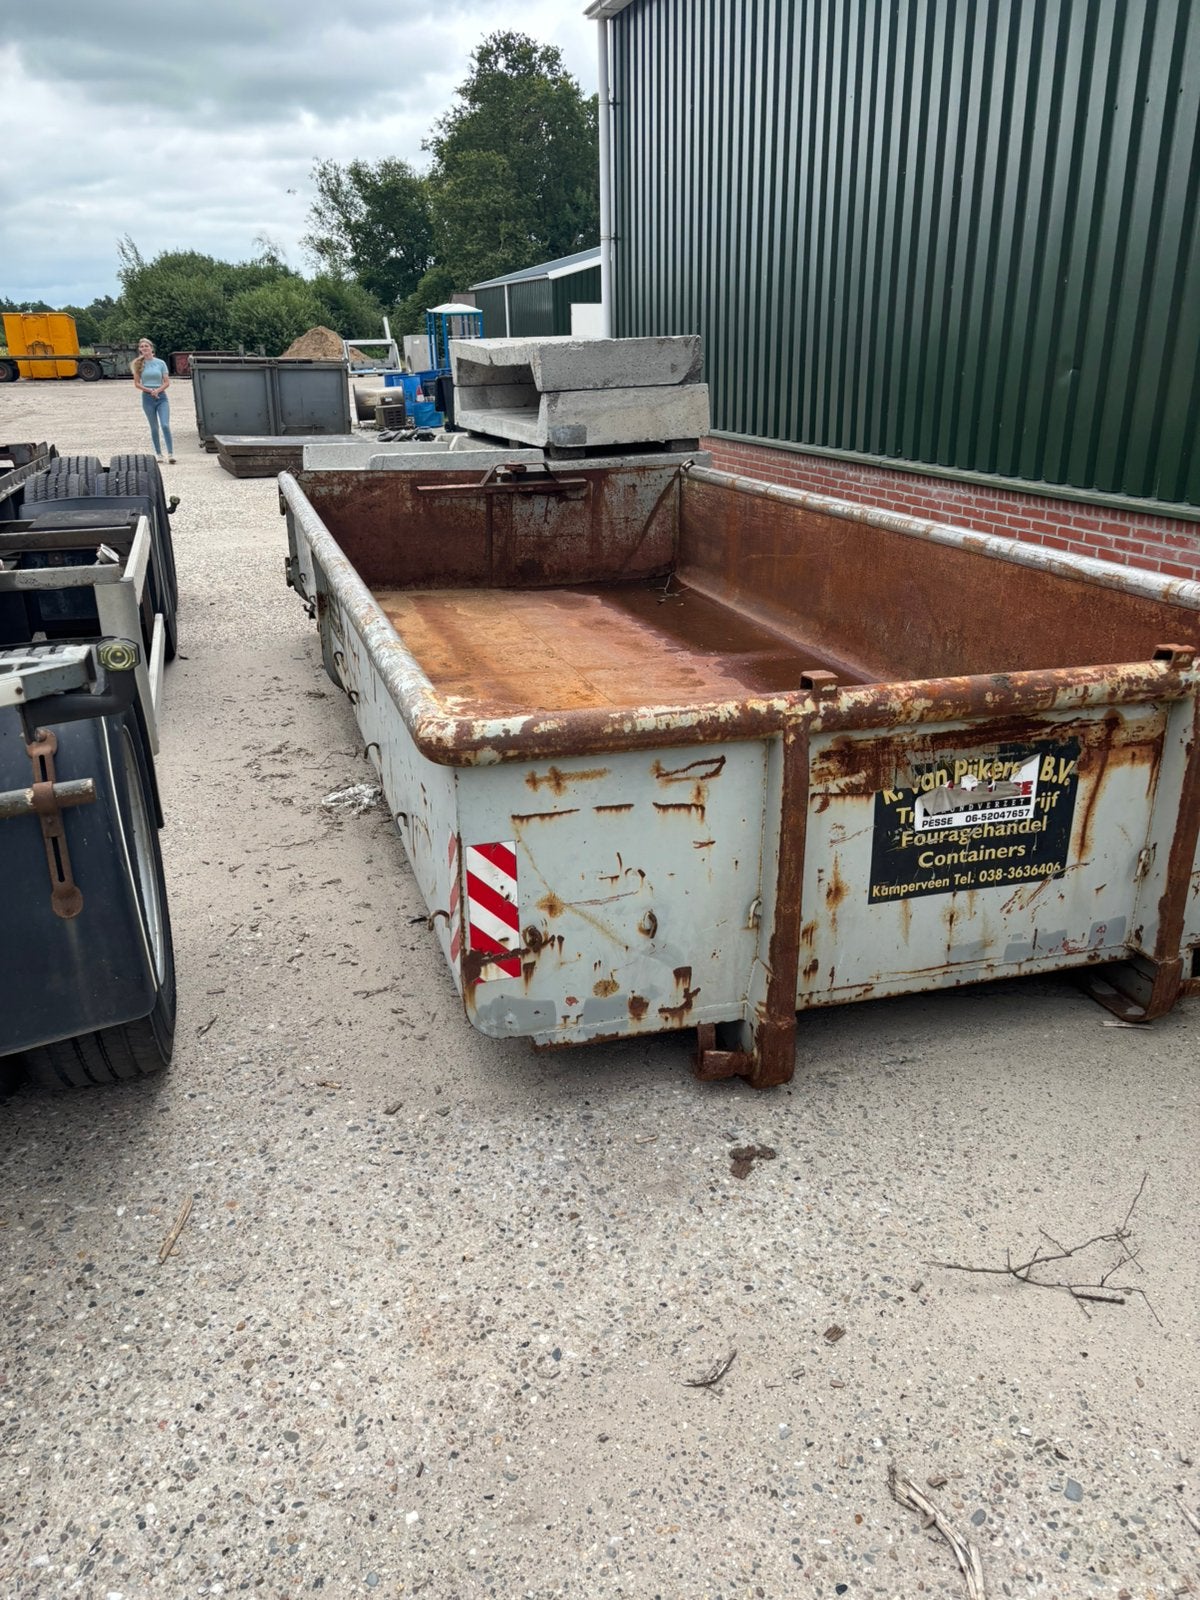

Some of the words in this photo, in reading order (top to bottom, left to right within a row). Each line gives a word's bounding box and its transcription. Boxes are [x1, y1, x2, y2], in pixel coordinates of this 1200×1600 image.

[911, 768, 947, 795] van
[1039, 756, 1076, 786] B.V.
[901, 815, 1047, 847] Fouragehandel
[922, 817, 953, 829] PESSE
[965, 809, 1031, 823] 06-52047657
[918, 845, 1026, 869] Containers
[954, 872, 975, 886] Tel.
[979, 861, 1061, 883] 038-3636406
